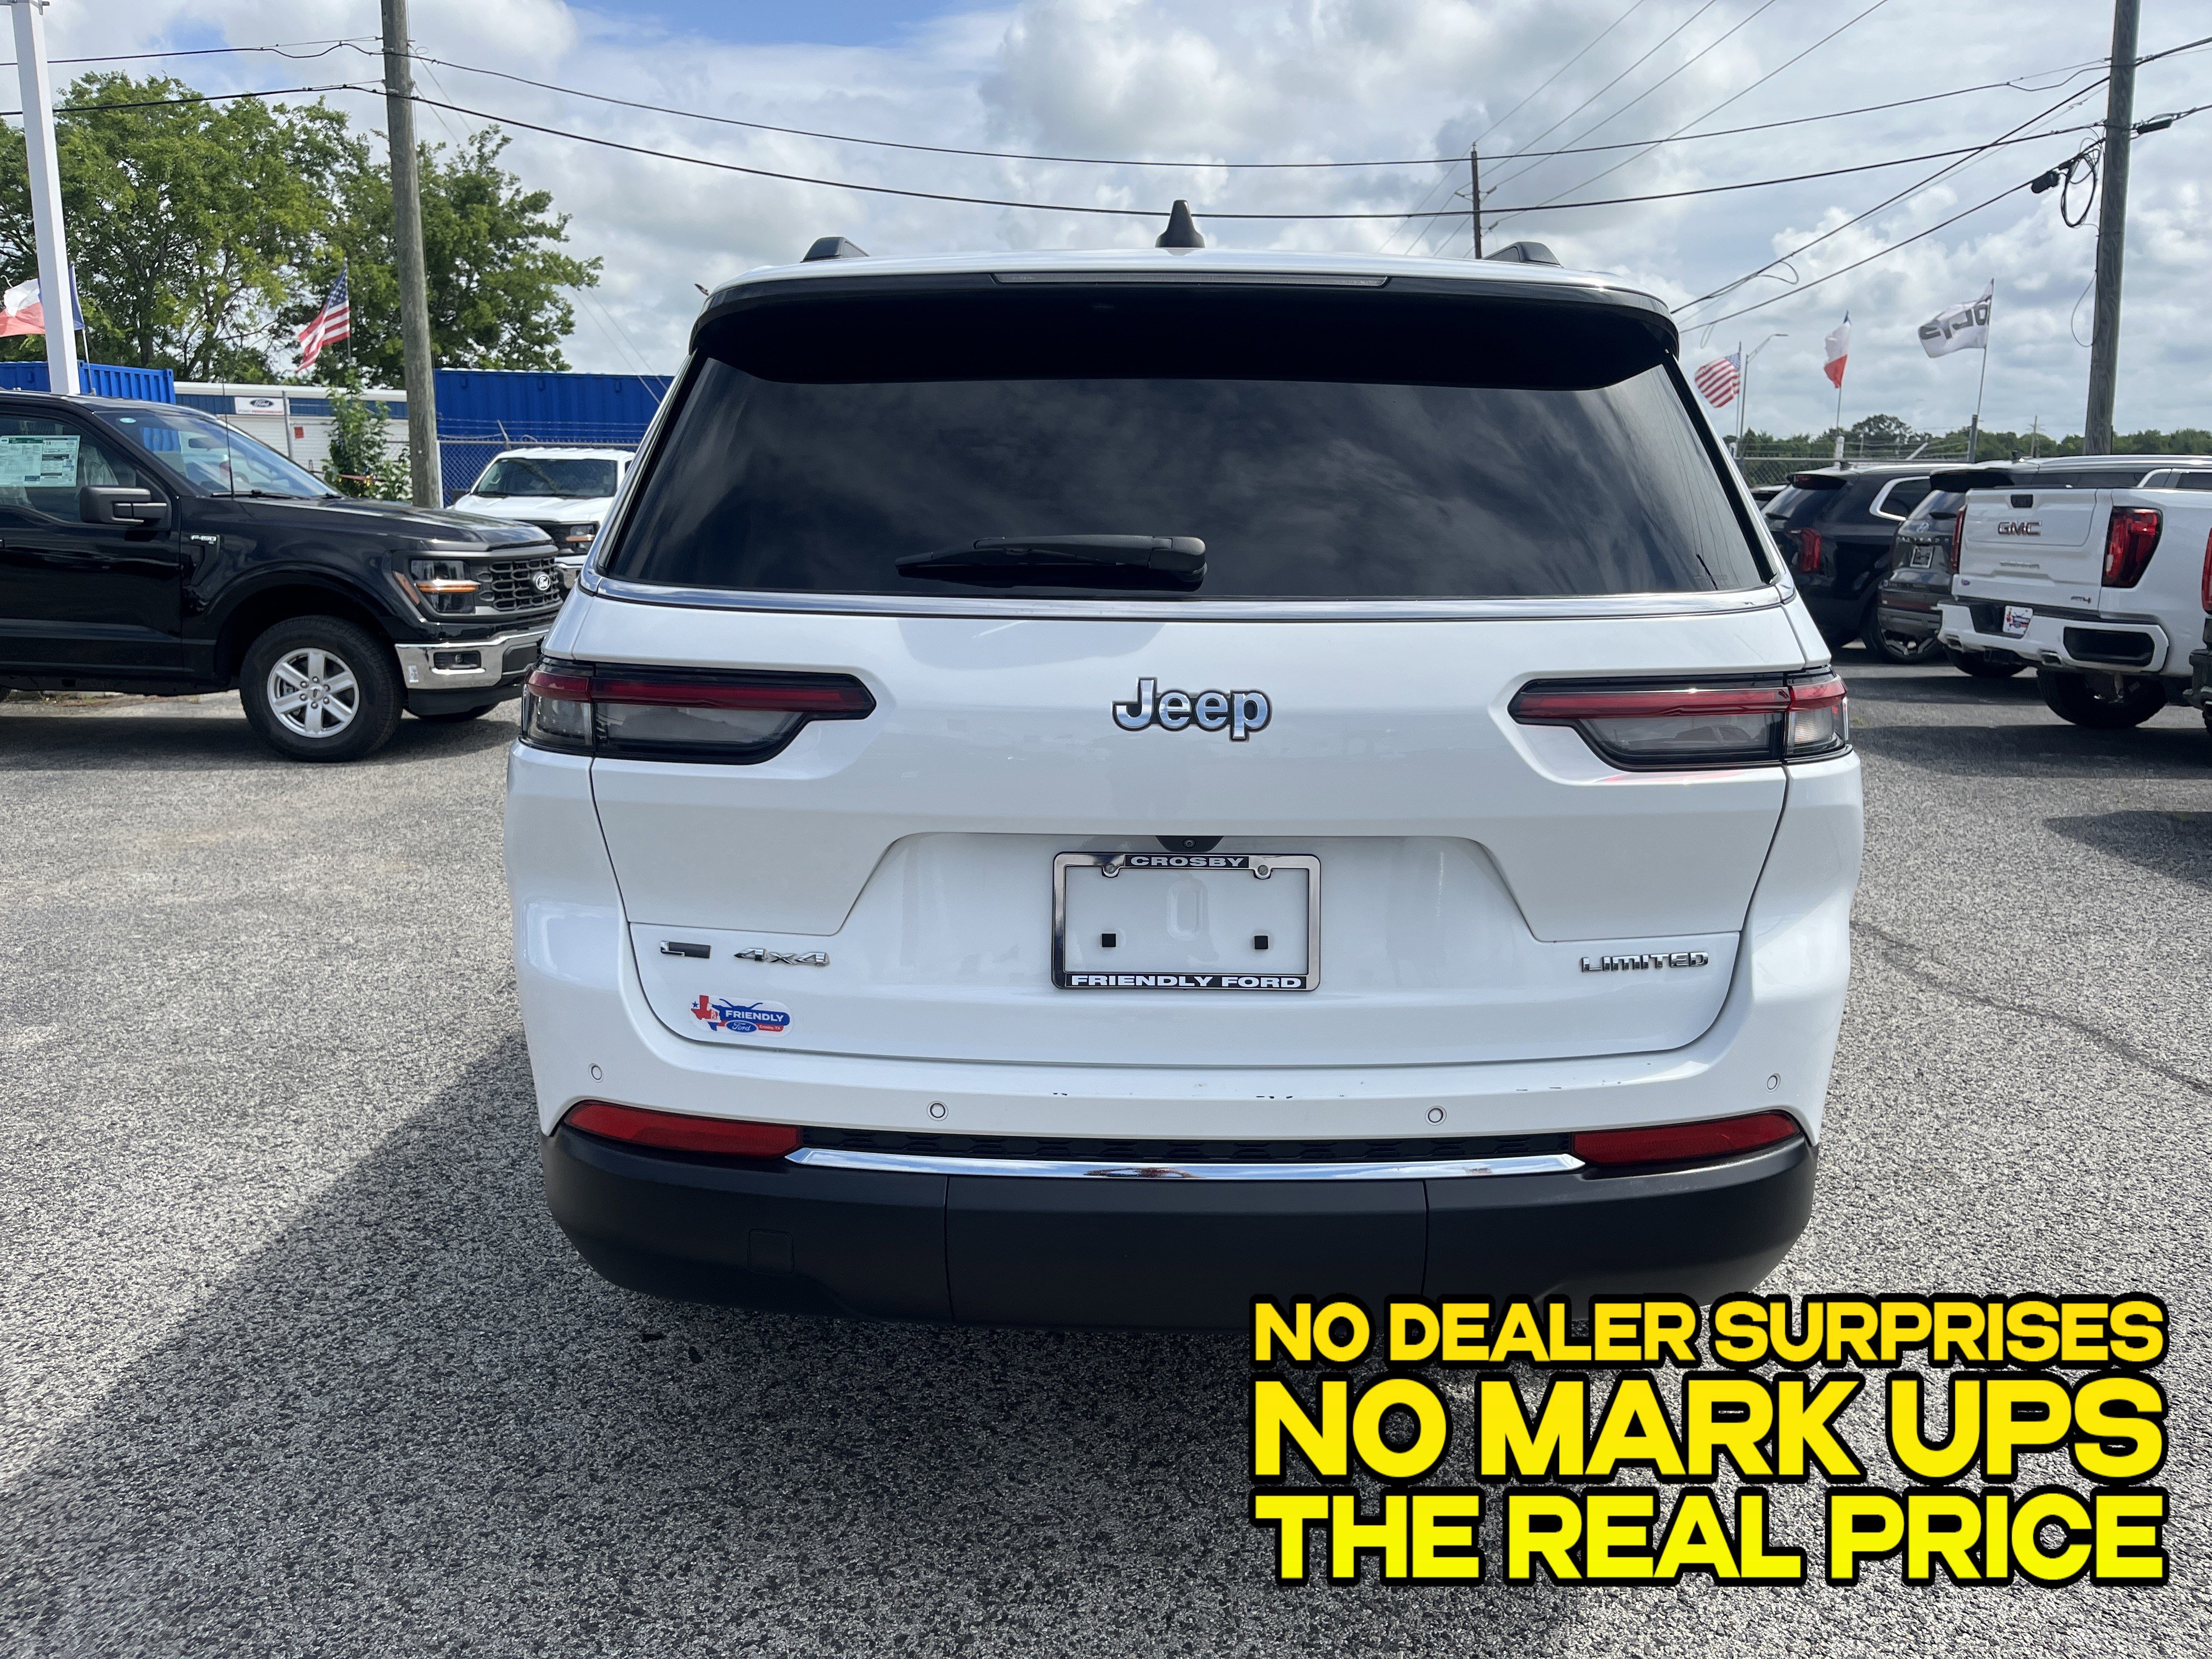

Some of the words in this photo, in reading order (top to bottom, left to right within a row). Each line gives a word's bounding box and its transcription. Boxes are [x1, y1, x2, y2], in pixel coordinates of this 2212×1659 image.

[1998, 522, 2041, 536] GMC
[1111, 676, 1272, 742] Jeep
[1130, 856, 1244, 868] CROSBY
[1581, 951, 1708, 973] LIMITED
[1071, 974, 1214, 988] FRIENDLY
[1221, 976, 1302, 988] FORD
[725, 1009, 784, 1022] FRIENDLY
[731, 1022, 751, 1032] Ford
